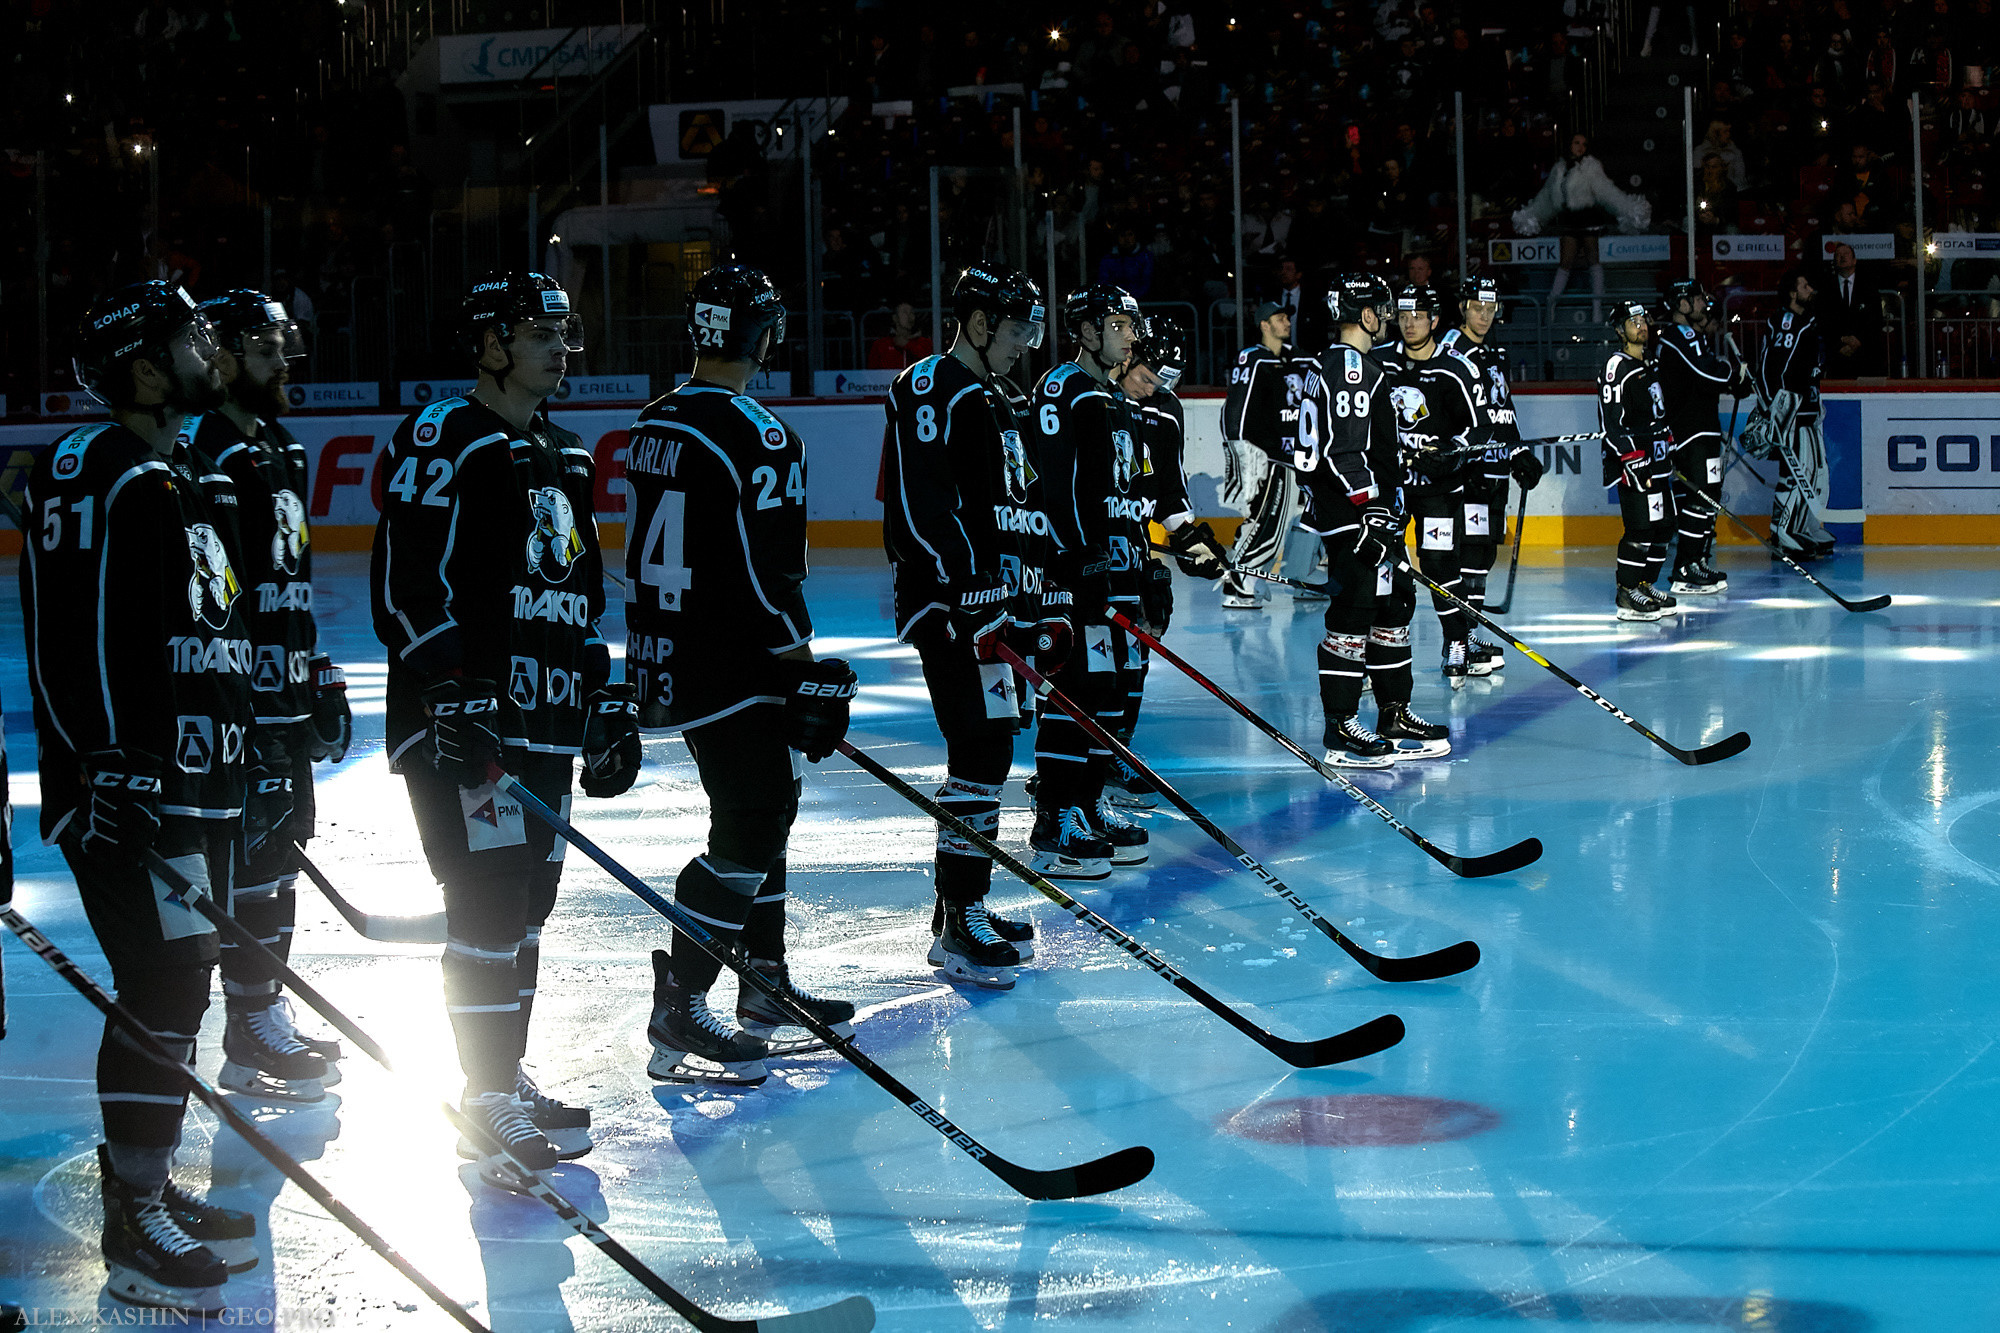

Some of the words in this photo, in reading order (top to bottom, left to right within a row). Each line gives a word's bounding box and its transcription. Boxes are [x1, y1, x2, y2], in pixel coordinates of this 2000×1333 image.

[1517, 246, 1556, 261] ЮГК
[1737, 244, 1782, 253] ERIELL
[471, 281, 509, 294] КОНАР
[969, 267, 999, 284] КОНАР
[93, 302, 141, 330] КОНАР
[472, 311, 495, 321] CCM
[114, 338, 144, 358] CCM
[699, 327, 724, 348] 24
[1774, 332, 1795, 349] 28
[1173, 346, 1181, 360] 2
[1231, 366, 1250, 384] 94
[313, 390, 365, 402] ERIELL
[579, 383, 635, 394] ERIELL
[1602, 383, 1621, 404] 91
[1335, 390, 1370, 418] 89
[915, 404, 938, 443] 8
[1039, 403, 1061, 435] 6
[1294, 398, 1320, 473] 9
[1557, 431, 1607, 444] CCM
[626, 435, 683, 478] KARLIN
[388, 456, 455, 508] 42
[1783, 445, 1815, 501] BAUER
[751, 462, 806, 511] 24
[41, 495, 95, 551] 51
[1235, 562, 1289, 584] BAUER
[510, 585, 589, 628] TRAKTO
[165, 635, 252, 675] TRAKTO
[797, 681, 860, 699] BAUE
[1576, 683, 1635, 725] CCM
[498, 803, 521, 818] РМК
[1331, 776, 1405, 832] BAUER
[1236, 851, 1322, 924] BAUER
[1081, 909, 1184, 985] BAUER
[908, 1100, 988, 1160] BAUER
